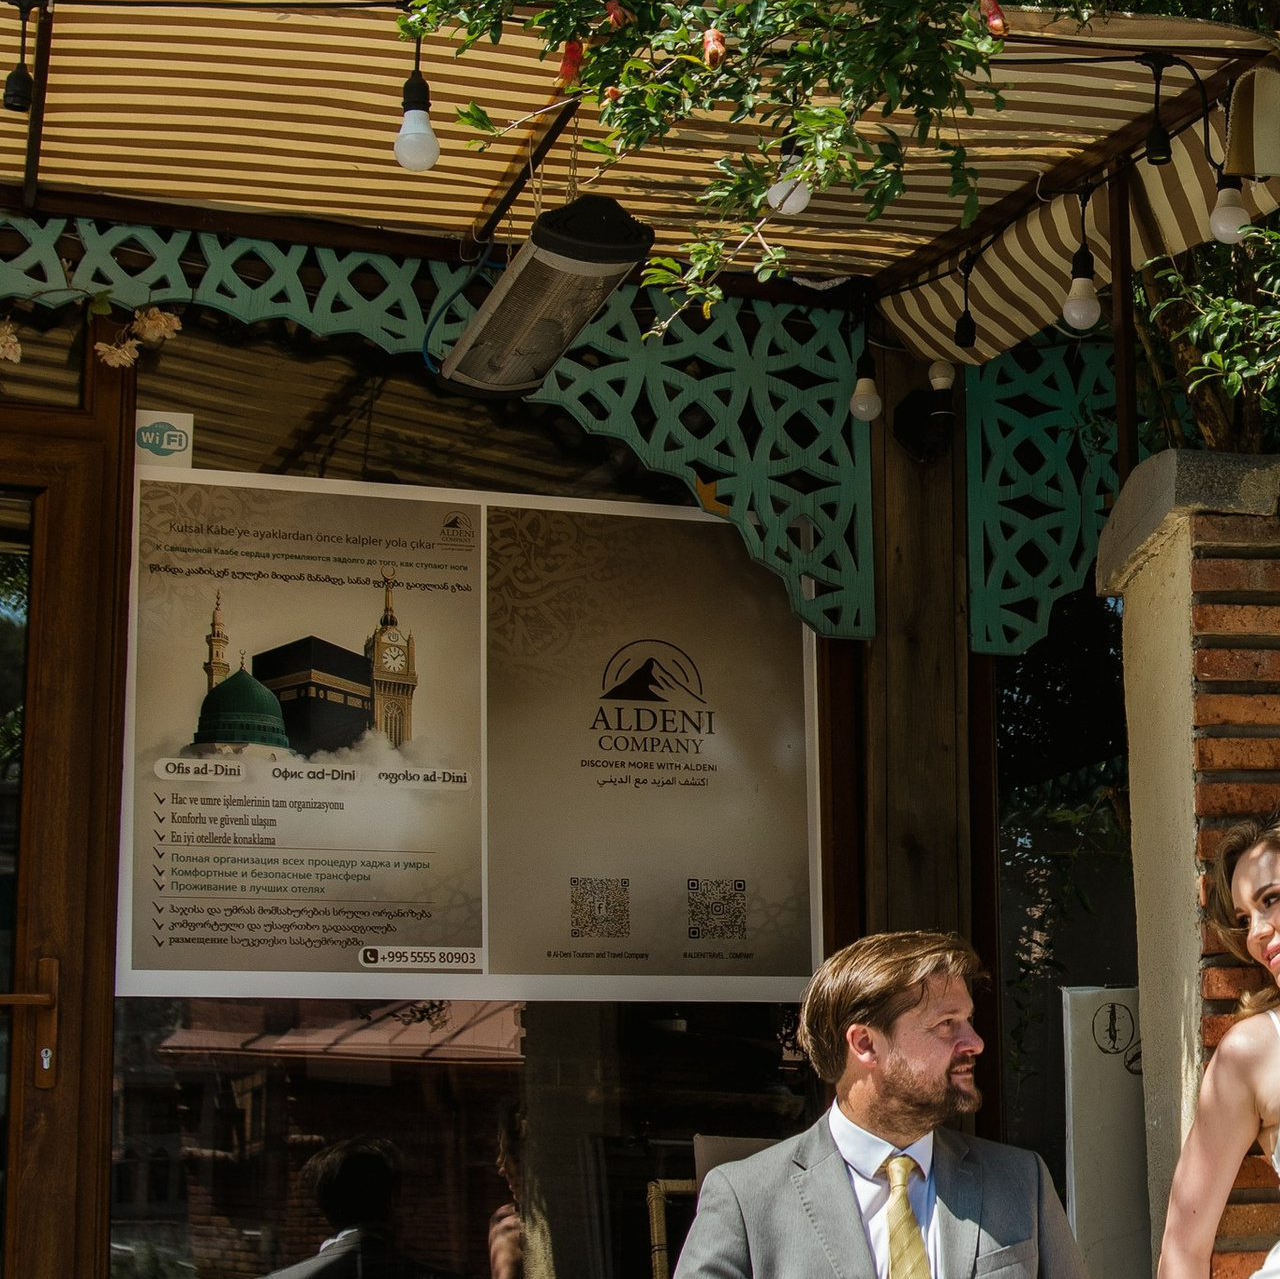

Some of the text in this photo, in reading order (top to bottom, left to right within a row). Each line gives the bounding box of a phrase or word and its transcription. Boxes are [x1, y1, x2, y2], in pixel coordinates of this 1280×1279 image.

[170, 523, 203, 534] Kutsal
[253, 528, 313, 541] ayaklardan
[316, 532, 343, 544] önce
[346, 534, 382, 548] kalpler
[385, 538, 407, 549] yola
[411, 539, 436, 551] çıkar
[440, 529, 475, 538] ALDENI
[164, 545, 212, 554] Священной
[214, 548, 239, 556] Каабе
[241, 551, 270, 559] сердца
[272, 553, 331, 562] устремляются
[332, 557, 365, 565] задолго
[379, 560, 398, 568] того,
[416, 562, 448, 570] ступают
[149, 564, 183, 575] წმინდა
[231, 570, 269, 580] გულები
[271, 571, 305, 583] მიდიან
[348, 576, 371, 585] სანამ
[406, 581, 449, 591] გაივლიან
[451, 583, 472, 593] გზას
[589, 706, 716, 735] ALDENI
[598, 735, 704, 754] COMPANY
[165, 762, 241, 776] Ofis ad-Dini
[581, 760, 717, 772] DISCOVER MORE WITH ALDENI
[272, 767, 356, 781] Офис ad-Dini
[423, 771, 467, 783] ad-Dini
[597, 775, 709, 789] اكتشف المزيد مع الديني
[171, 793, 345, 813] Hac ve umre işlemlerinin tam organizasyonu
[171, 812, 277, 829] Konforlu ve güvenli ulaşım
[170, 831, 276, 845] En iyi otellerde konaklama
[171, 853, 430, 870] Полная организация всех процедур хаджа и умры
[171, 867, 238, 879] Комфортные
[251, 869, 312, 880] безопасные
[315, 872, 371, 882] трансферы
[171, 881, 238, 892] Проживание
[250, 884, 288, 894] лучших
[291, 885, 326, 893] отелях
[207, 906, 222, 916] და
[224, 905, 256, 916] უმრას
[333, 907, 370, 919] სრული
[372, 908, 432, 920] ორგანიზება
[169, 919, 397, 934] კომფორტული და უსაფრთხო გადაადგილება
[169, 935, 229, 946] размещение
[231, 935, 287, 947] საუკეთესო
[380, 951, 476, 964] +995 5555 80903
[573, 951, 595, 959] Tourism
[624, 952, 649, 961] Company
